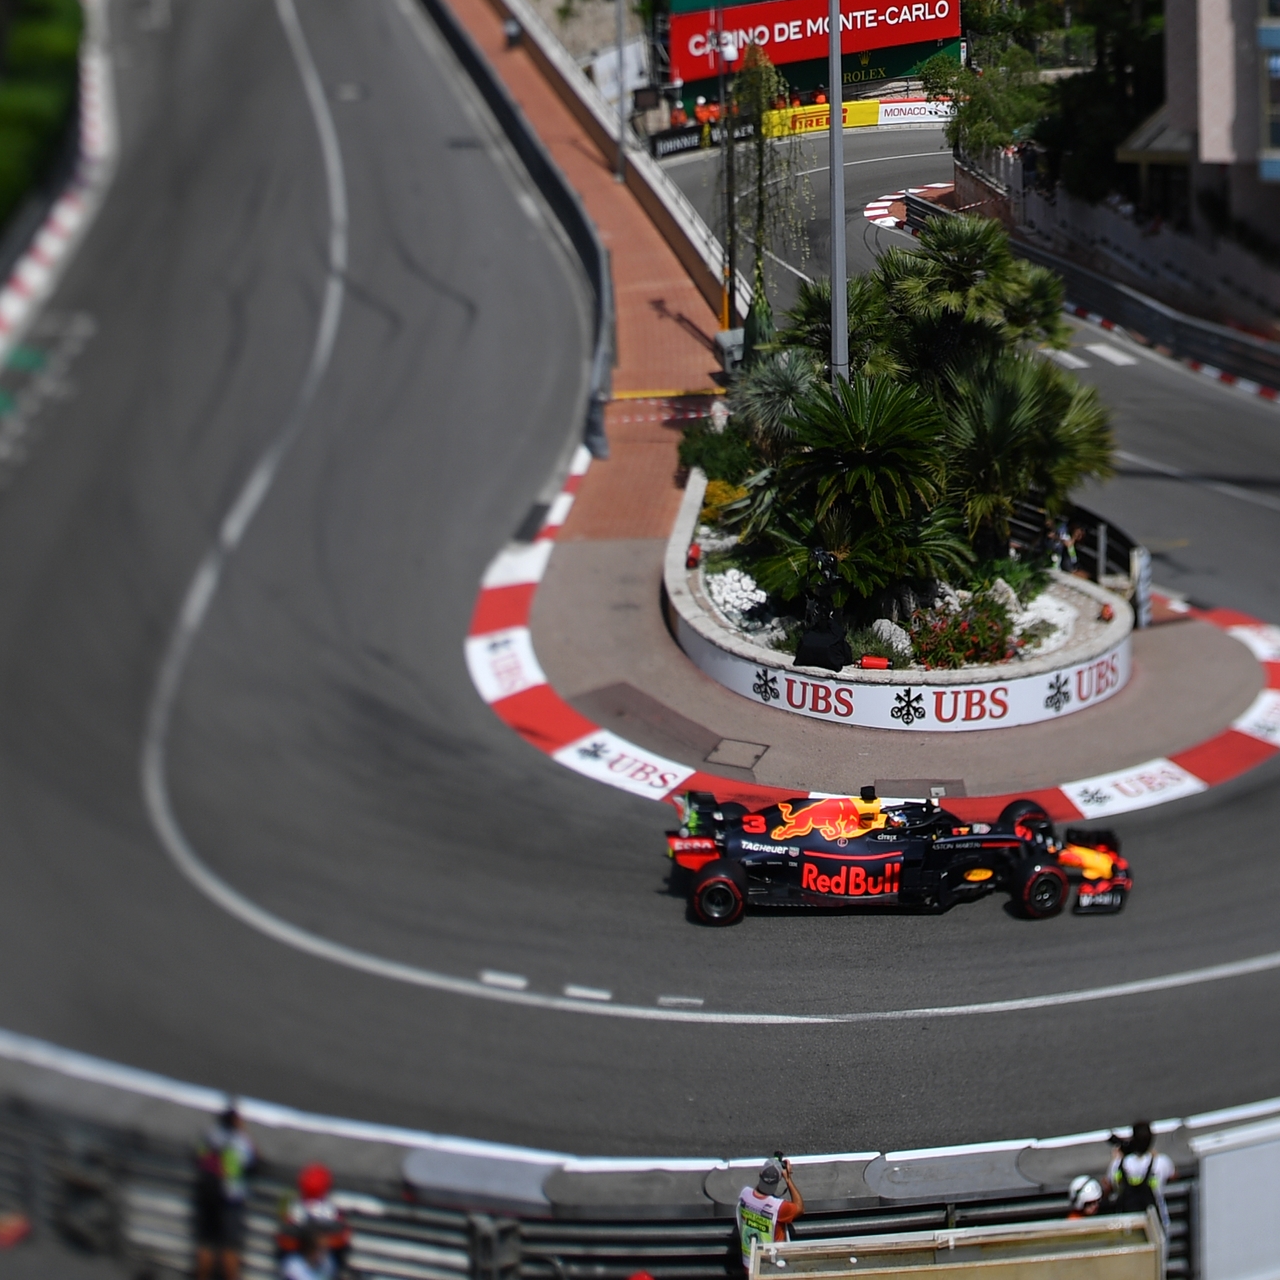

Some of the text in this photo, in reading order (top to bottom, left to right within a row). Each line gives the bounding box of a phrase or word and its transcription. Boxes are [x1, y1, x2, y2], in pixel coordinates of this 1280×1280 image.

[774, 20, 803, 42] DE
[843, 67, 887, 84] ROLEX
[791, 107, 849, 131] PIREI
[883, 106, 927, 118] MONACO
[1076, 653, 1119, 702] UBS
[785, 677, 855, 718] UBS
[932, 686, 1009, 723] UBS
[607, 752, 678, 789] UBS
[742, 814, 767, 834] 3
